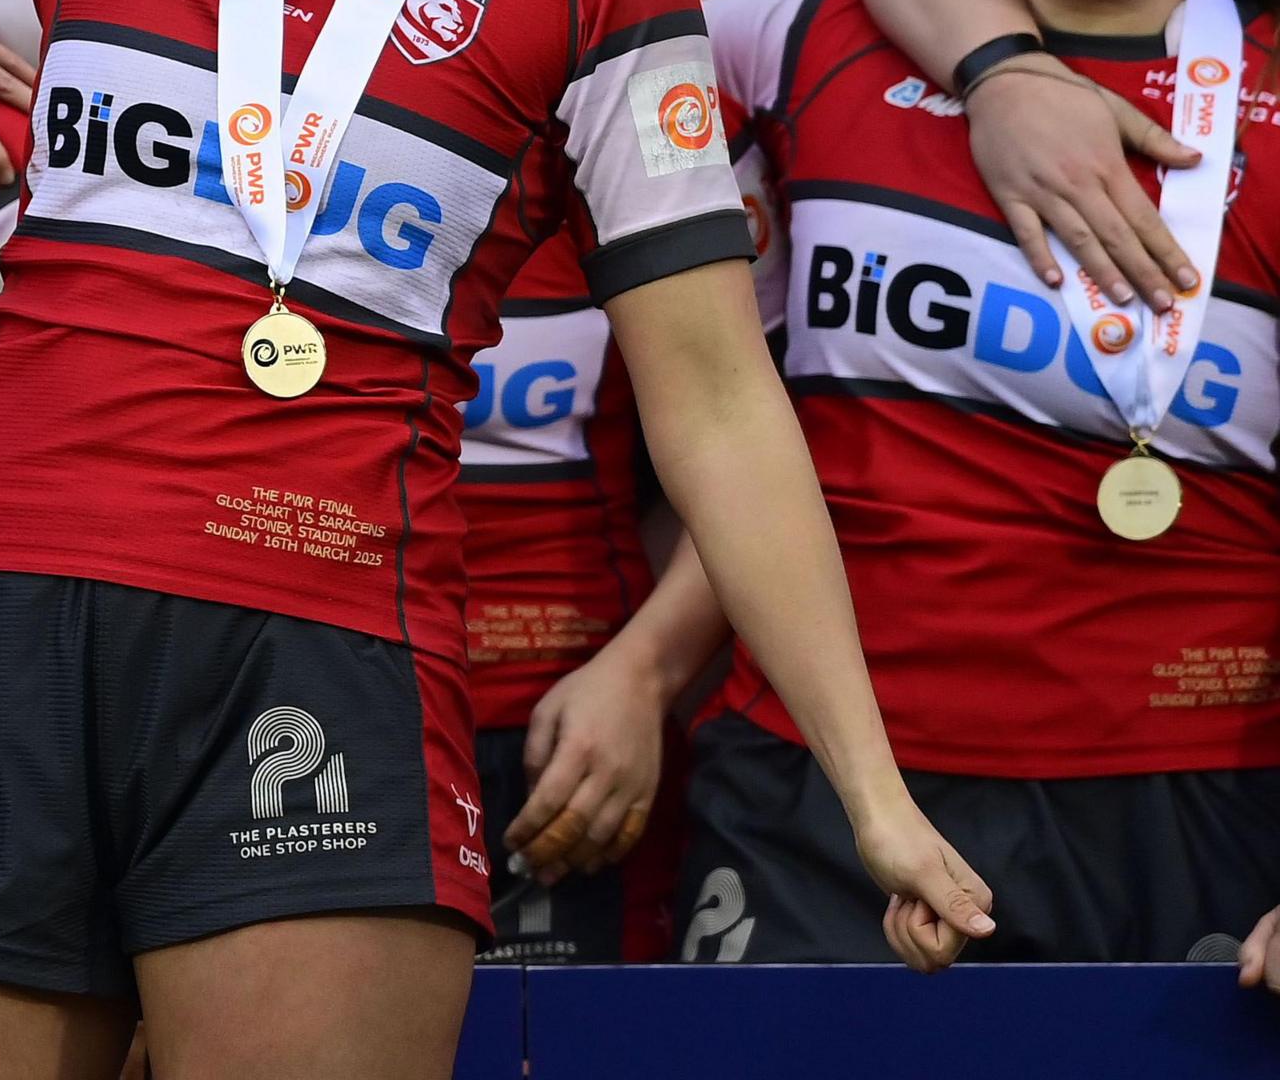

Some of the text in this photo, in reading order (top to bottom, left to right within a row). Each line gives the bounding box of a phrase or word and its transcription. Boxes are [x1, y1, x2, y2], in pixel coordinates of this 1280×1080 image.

[282, 3, 314, 23] EN
[412, 34, 430, 48] 1873
[1199, 93, 1216, 137] PWR
[290, 112, 324, 166] PWR
[246, 152, 265, 207] PWR
[283, 342, 318, 357] PWR
[1163, 309, 1183, 356] PWR
[215, 494, 387, 539] GLOS-HART VS SARACENS
[252, 486, 358, 519] THE PWR FINAL
[204, 521, 384, 567] SUNDAY 16TH MARCH 2025
[240, 514, 359, 549] STONEX STADIUM
[230, 822, 378, 845] THE PLASTERERS
[240, 837, 367, 859] ONE STOP SHOP
